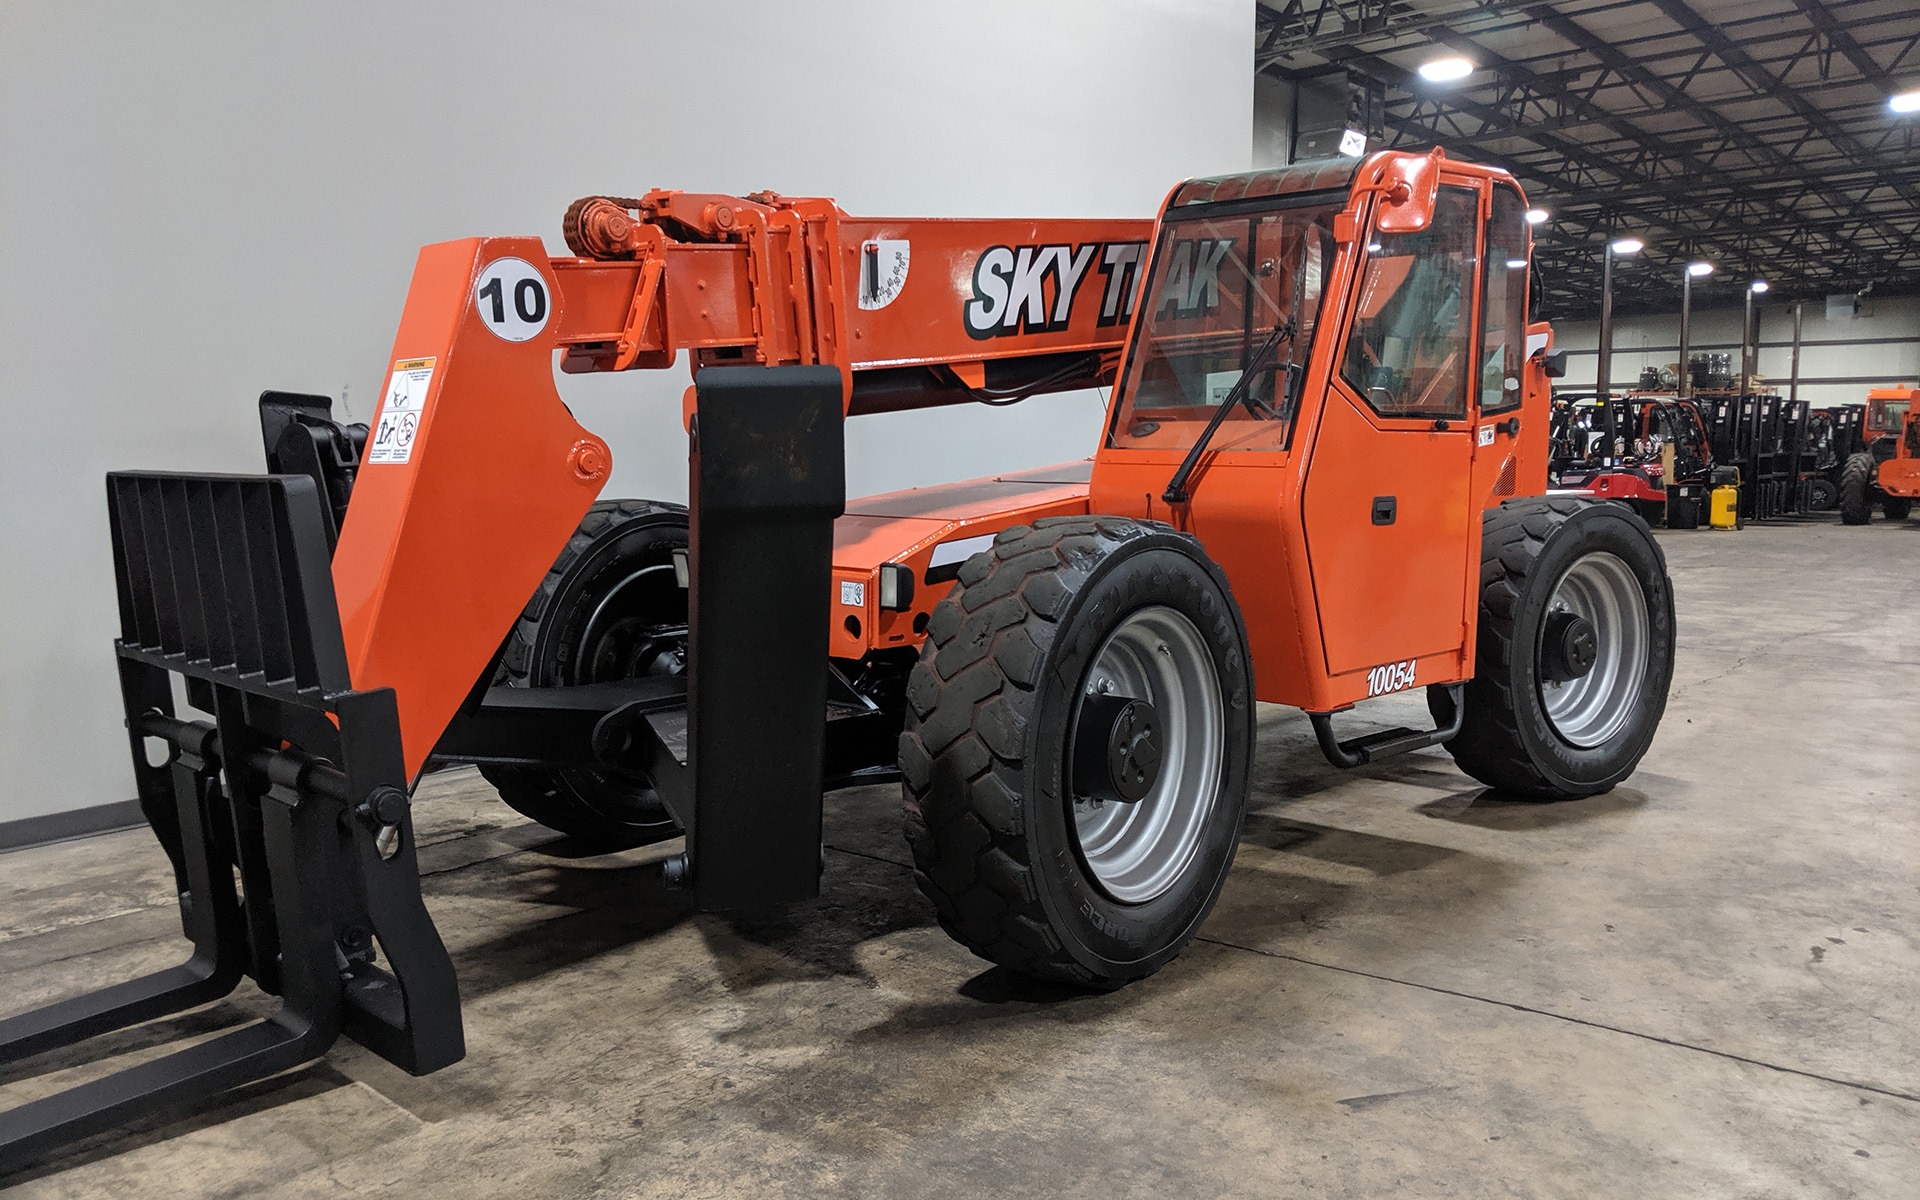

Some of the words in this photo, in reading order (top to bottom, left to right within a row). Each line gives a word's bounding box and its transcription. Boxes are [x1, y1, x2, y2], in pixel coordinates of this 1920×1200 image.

[895, 251, 902, 261] 80
[898, 261, 906, 270] 70
[893, 266, 900, 276] 60
[893, 276, 901, 286] 50
[964, 243, 1101, 340] SKY
[479, 277, 546, 323] 10
[1366, 658, 1417, 698] 10054
